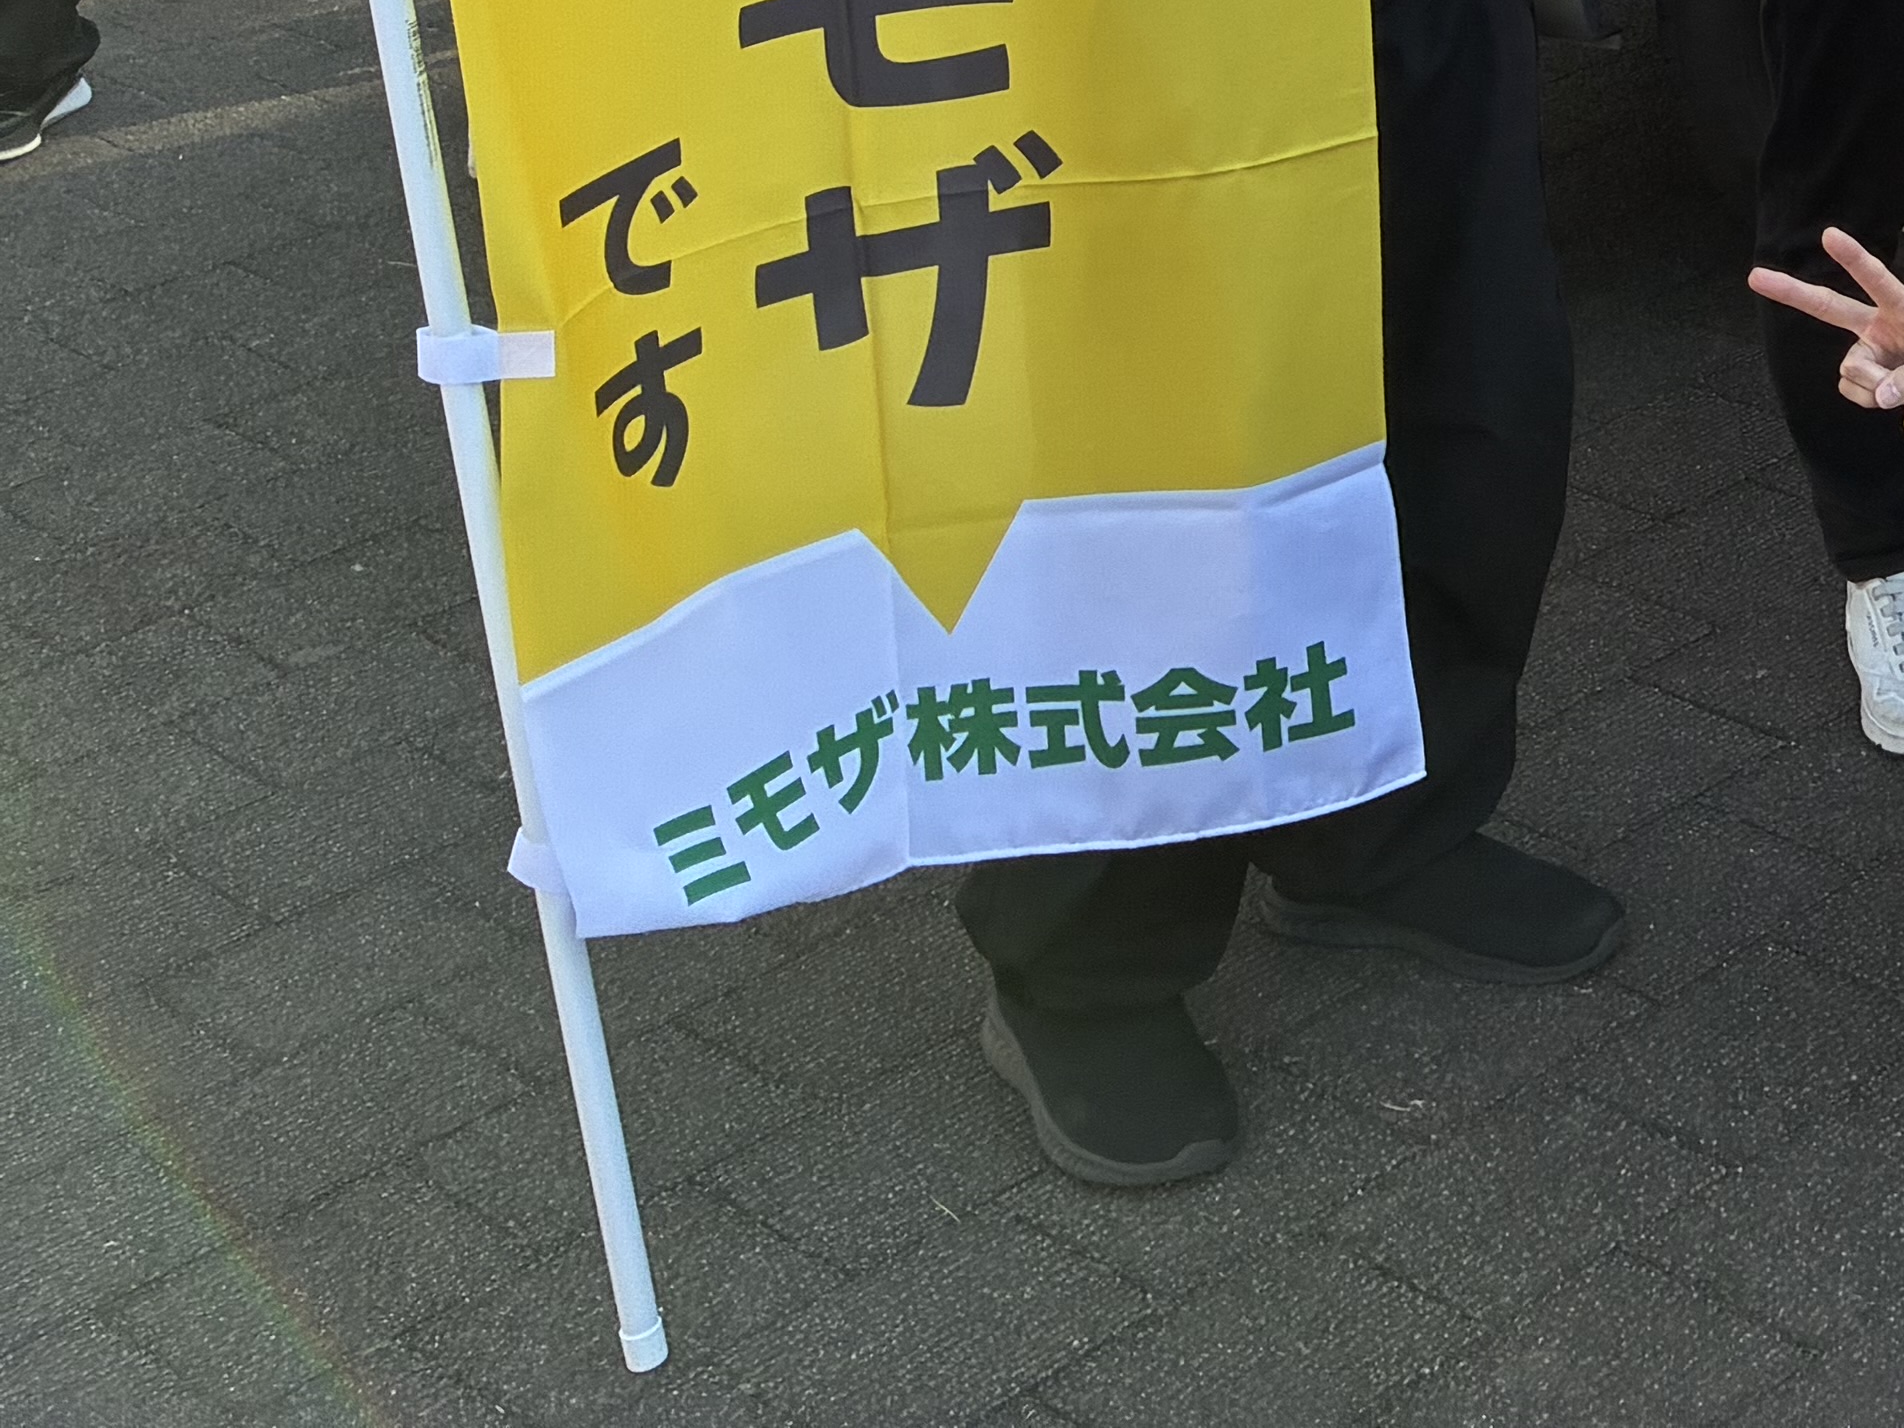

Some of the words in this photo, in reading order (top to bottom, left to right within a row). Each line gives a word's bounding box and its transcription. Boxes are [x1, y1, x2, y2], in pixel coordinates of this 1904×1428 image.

[559, 137, 703, 488] です
[654, 641, 1356, 906] ミモザ株式会社
